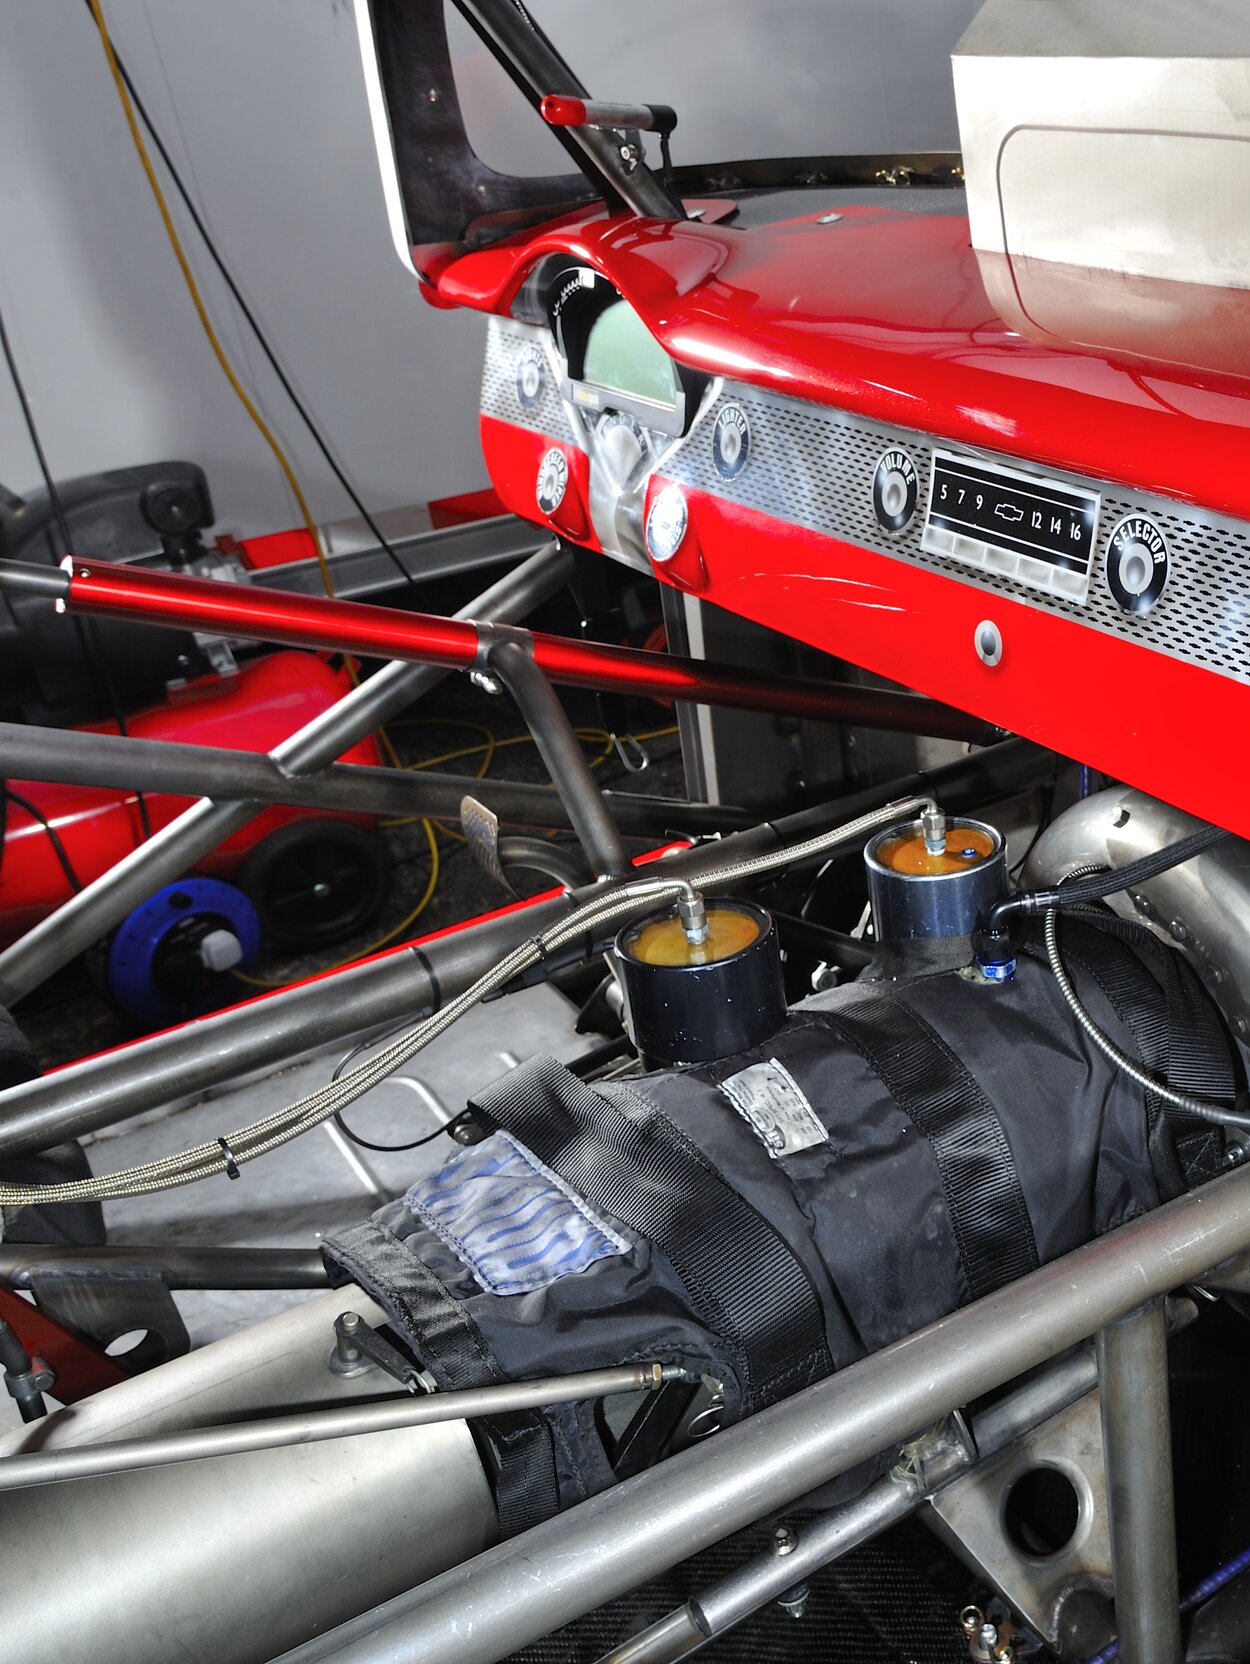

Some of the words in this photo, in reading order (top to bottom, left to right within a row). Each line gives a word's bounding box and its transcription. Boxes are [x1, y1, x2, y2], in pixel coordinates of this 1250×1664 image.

[719, 409, 746, 434] LIGHTER
[879, 453, 917, 485] VOLUME
[939, 484, 948, 500] 5
[958, 489, 966, 505] 7
[976, 495, 983, 510] 9
[1031, 511, 1042, 530] 12
[1050, 516, 1061, 535] 14
[1070, 522, 1082, 541] 16
[1113, 519, 1166, 564] SELECTOR
